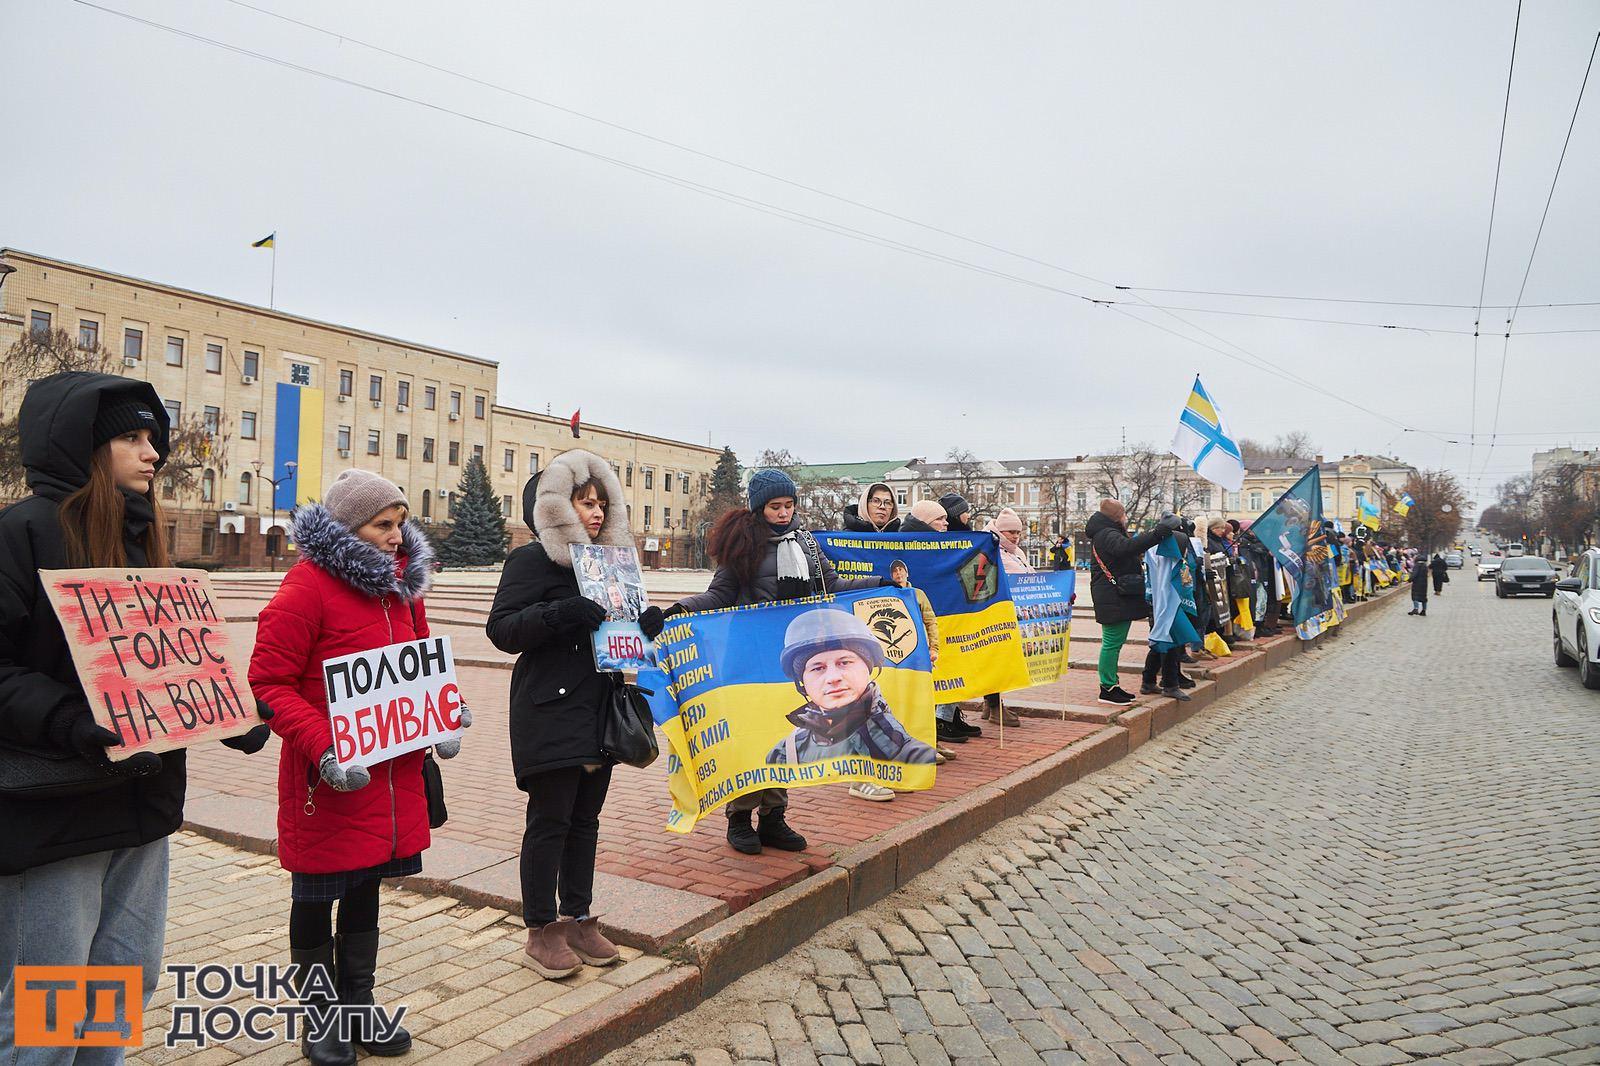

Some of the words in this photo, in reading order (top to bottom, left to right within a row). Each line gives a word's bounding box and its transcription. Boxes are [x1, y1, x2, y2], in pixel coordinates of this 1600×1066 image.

[833, 539, 862, 548] ОКРЕМА
[864, 540, 903, 550] ШТУРМОВА
[905, 540, 940, 550] КИЇВСЬКА
[940, 540, 974, 550] БРИГАДА
[838, 560, 873, 572] ДОДОМУ
[108, 626, 226, 678] ГОЛОС
[607, 635, 644, 660] НЕБО
[946, 632, 980, 645] МАЩЕНКО
[325, 638, 448, 704] ПОЛОН
[103, 688, 168, 748] НА
[167, 668, 247, 731] ВОЛІ
[332, 682, 462, 765] ВБИВАЄ
[701, 718, 730, 749] МІЙ
[735, 767, 796, 790] БРИГАДА
[876, 763, 903, 782] 3035
